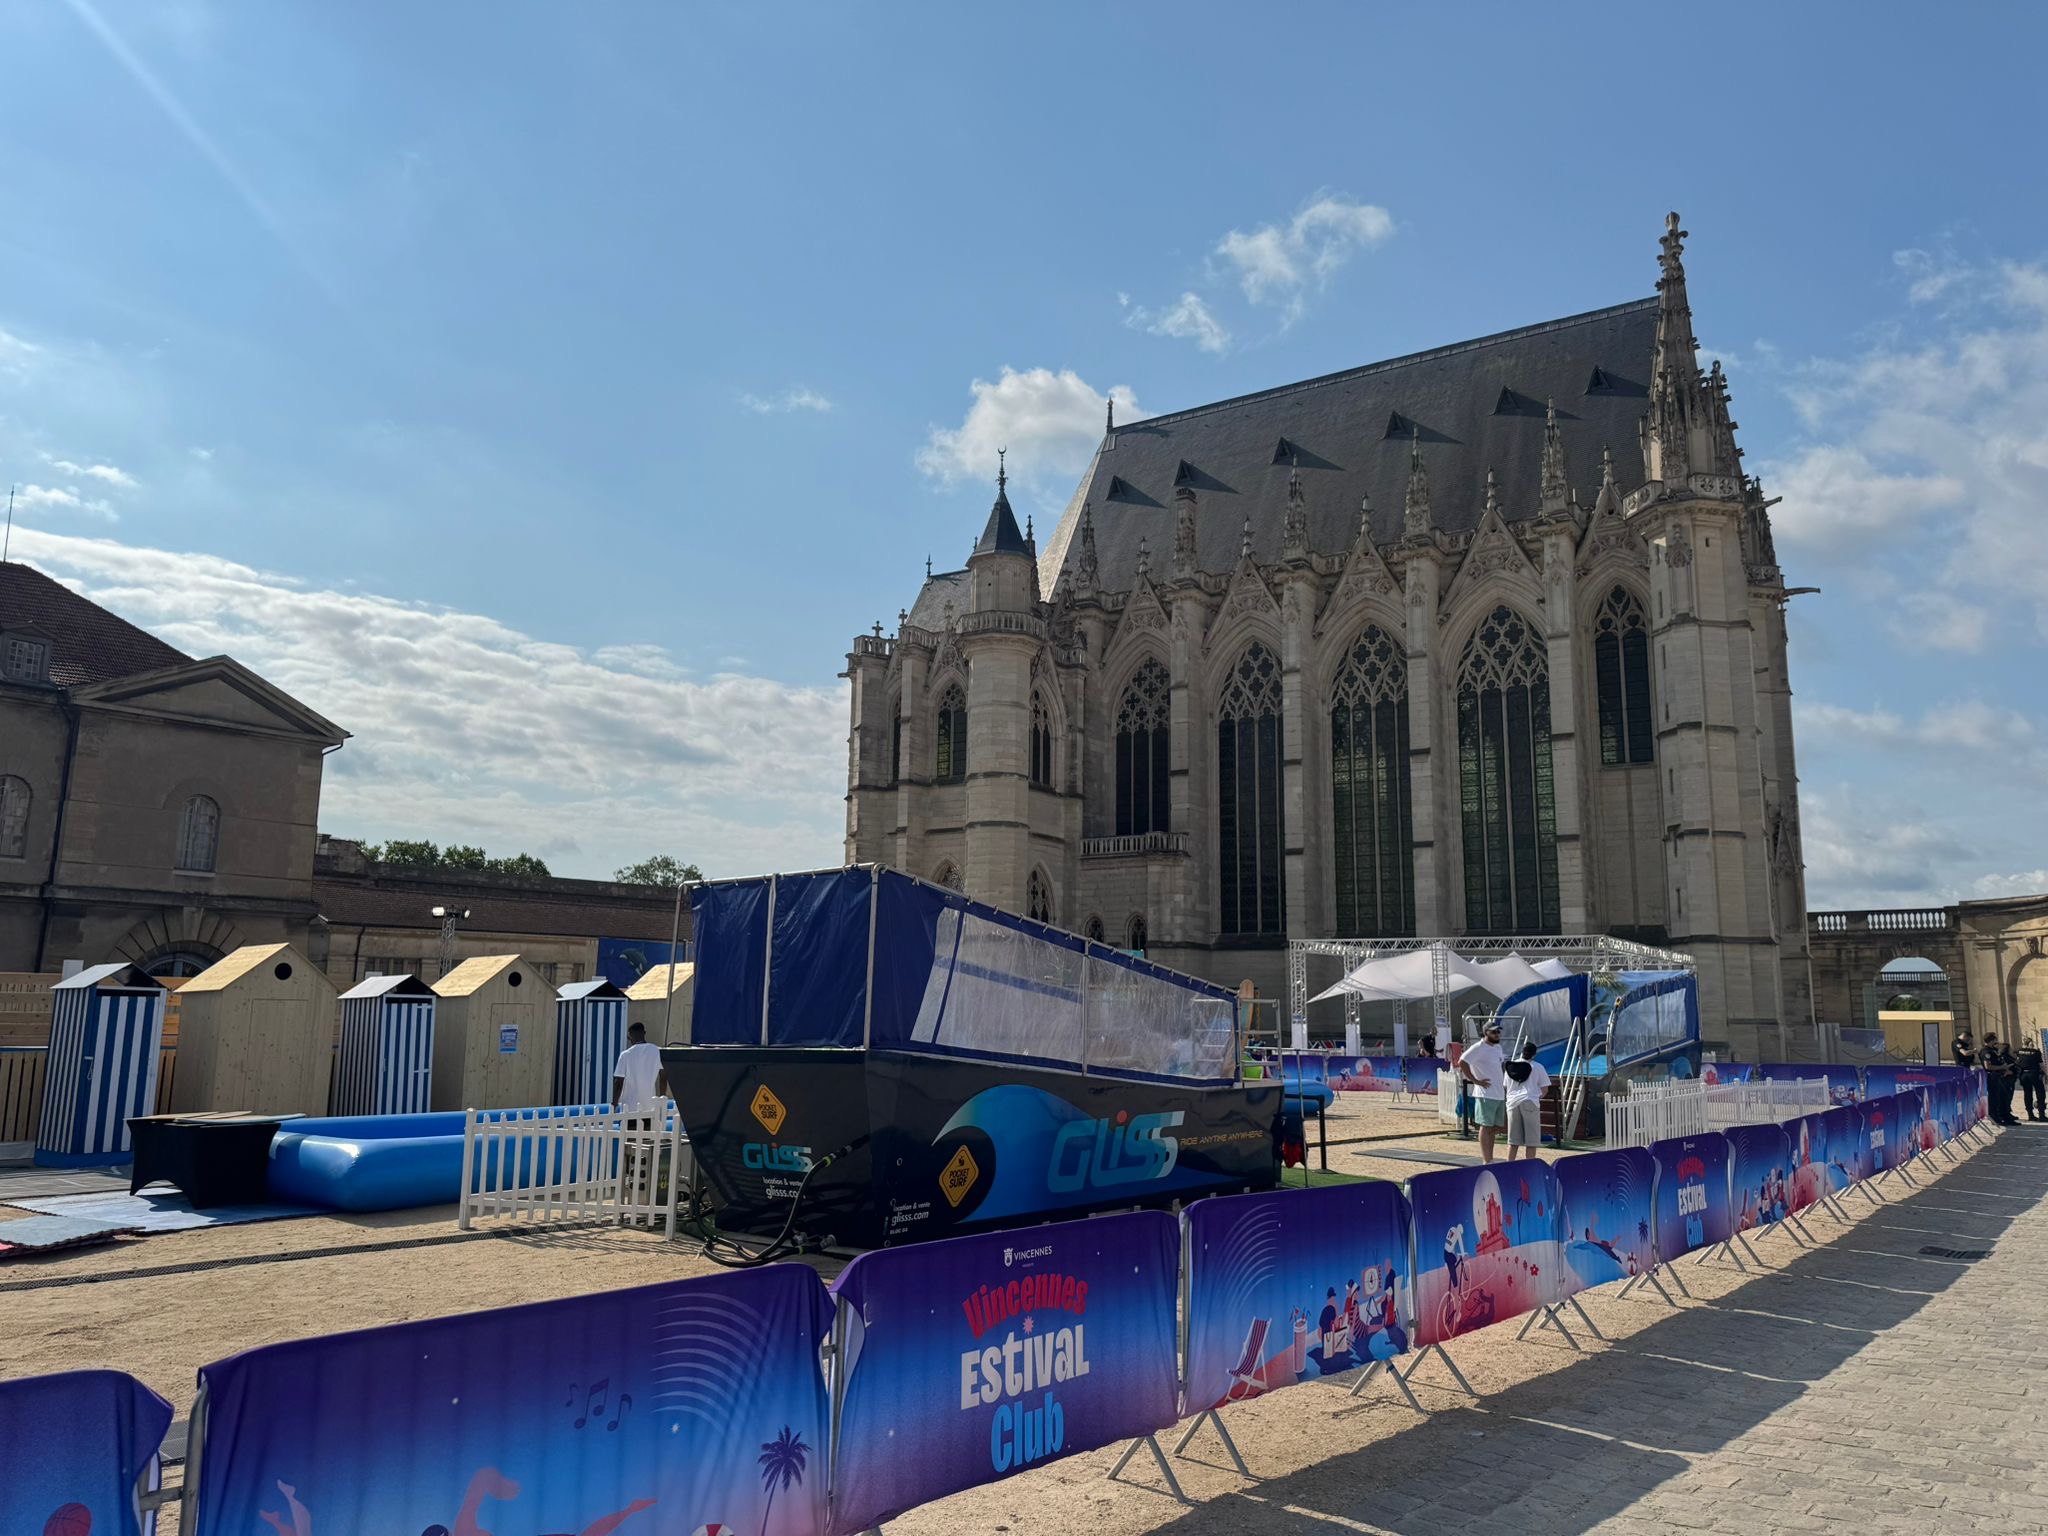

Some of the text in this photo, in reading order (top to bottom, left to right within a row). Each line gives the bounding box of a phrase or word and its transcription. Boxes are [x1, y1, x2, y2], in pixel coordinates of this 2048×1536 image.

[760, 1110, 778, 1119] SURF
[1179, 1137, 1198, 1146] RIDE
[948, 1168, 970, 1179] POCKET
[948, 1177, 968, 1189] SURF
[765, 1184, 807, 1200] glisss.co
[891, 1211, 930, 1227] glisss.com
[1013, 1245, 1053, 1261] VINCENNES
[962, 1273, 1089, 1340] Vincennes
[991, 1391, 1065, 1473] Club
